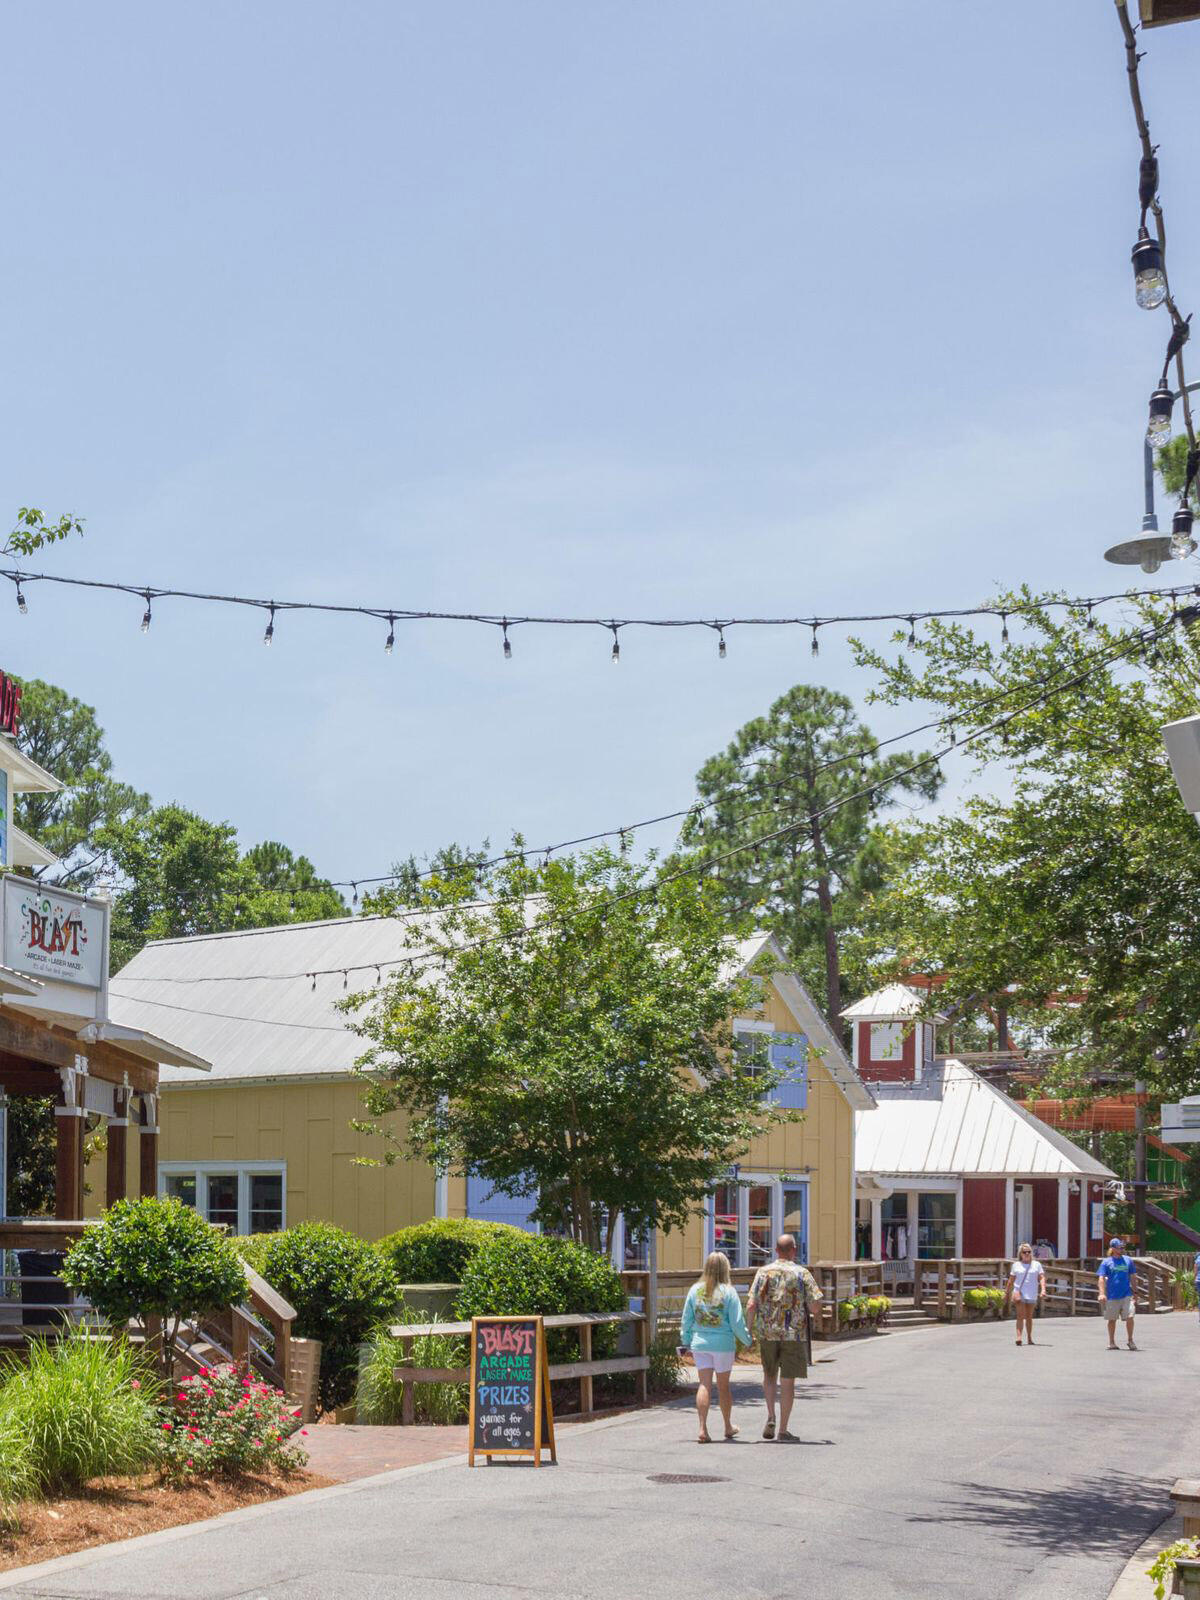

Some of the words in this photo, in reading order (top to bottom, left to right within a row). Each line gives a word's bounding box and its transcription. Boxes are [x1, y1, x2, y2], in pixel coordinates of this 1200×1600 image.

[28, 908, 83, 957] BLAST
[480, 1326, 535, 1355] BLAST
[480, 1356, 530, 1369] ARCADE
[480, 1369, 506, 1381] LASER
[509, 1369, 533, 1381] MAZE
[478, 1385, 530, 1405] PRIZES
[480, 1414, 505, 1428] games
[509, 1412, 522, 1423] for
[492, 1426, 502, 1436] all
[503, 1427, 521, 1441] ages
